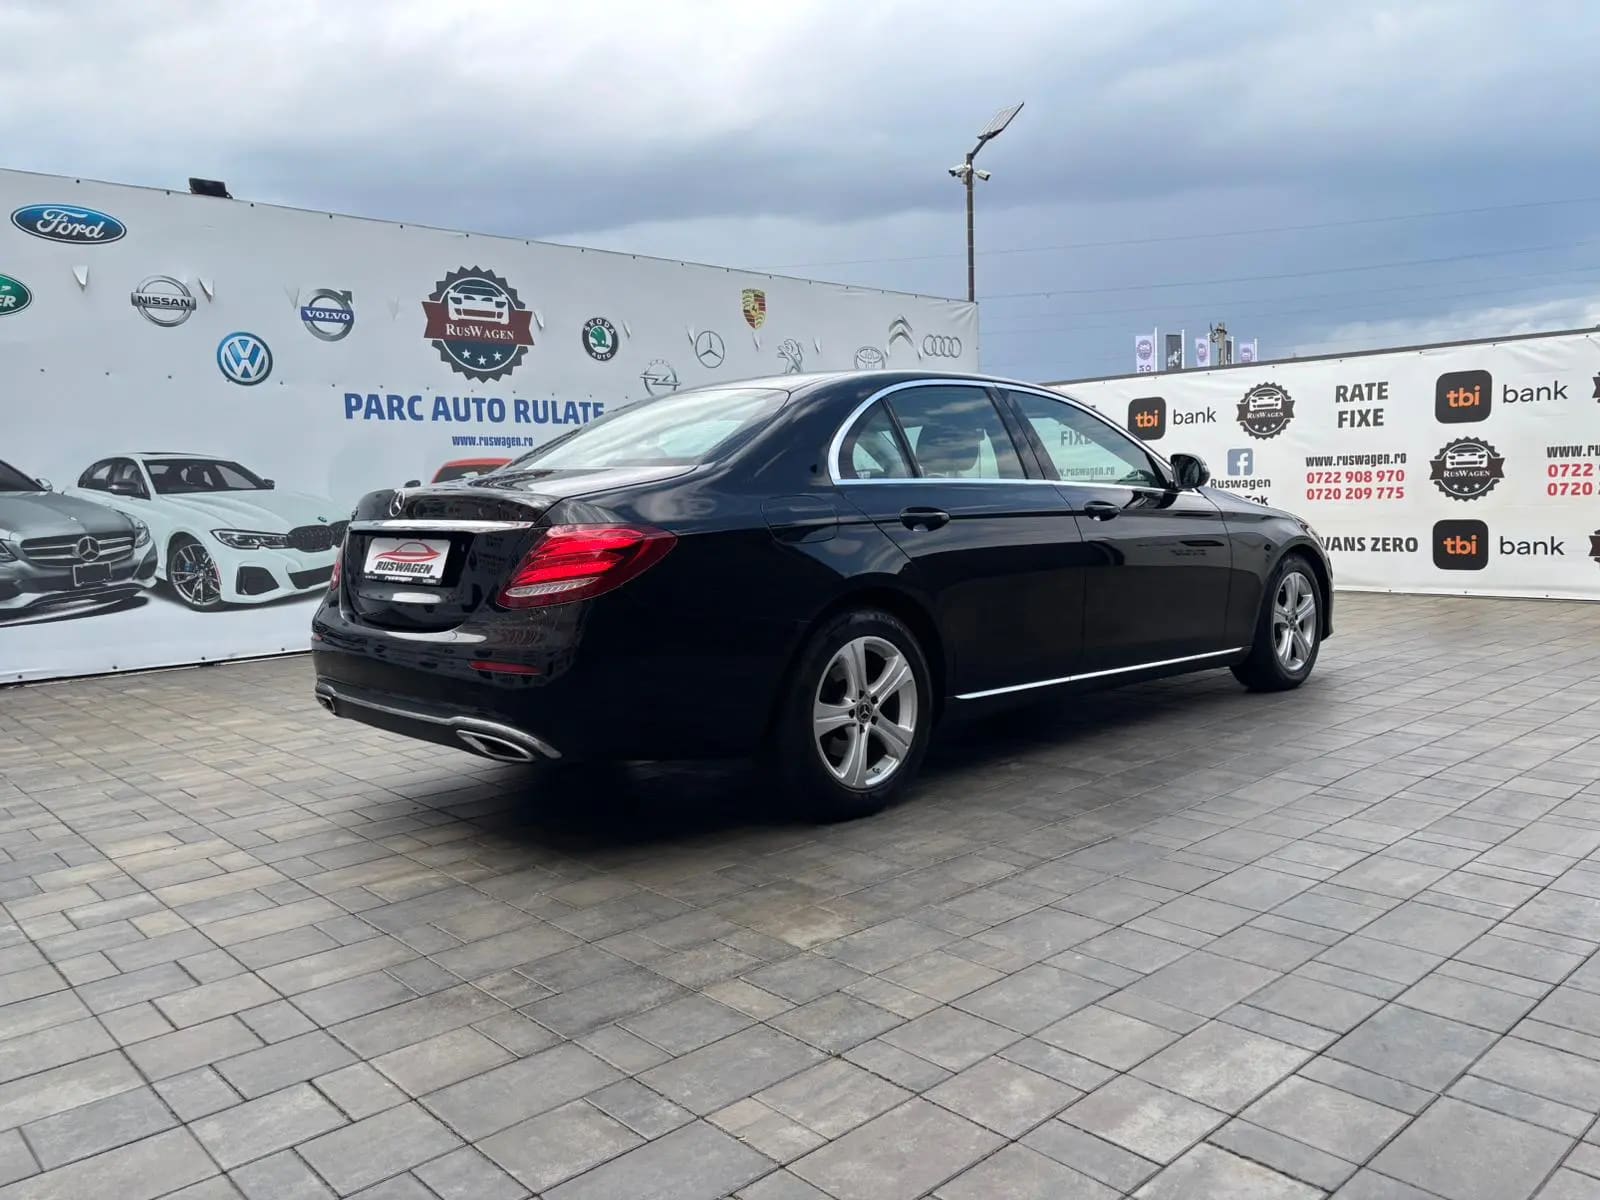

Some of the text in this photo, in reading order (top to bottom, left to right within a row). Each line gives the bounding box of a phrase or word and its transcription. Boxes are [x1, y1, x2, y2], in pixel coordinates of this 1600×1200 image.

[36, 209, 105, 240] Ford
[137, 295, 190, 308] NISSAN
[304, 310, 350, 321] VOLVO
[1335, 382, 1389, 403] RATE
[1446, 380, 1568, 408] tbi bank
[344, 393, 605, 425] PARC AUTO RULATE
[1135, 406, 1217, 427] tbi bank
[1337, 408, 1385, 429] FIXE
[451, 435, 534, 448] www.ruswagen.ro
[1305, 453, 1407, 468] www.ruswagen.ro
[1306, 470, 1405, 484] 0722 908 970
[1547, 463, 1593, 477] 0722
[1210, 479, 1271, 490] Ruswagen
[1547, 482, 1593, 496] 0720
[1306, 487, 1405, 500] 0720 209 775
[1370, 536, 1418, 552] ZERO
[1444, 534, 1565, 556] tbi bank
[375, 561, 433, 574] RUSWAGEN
